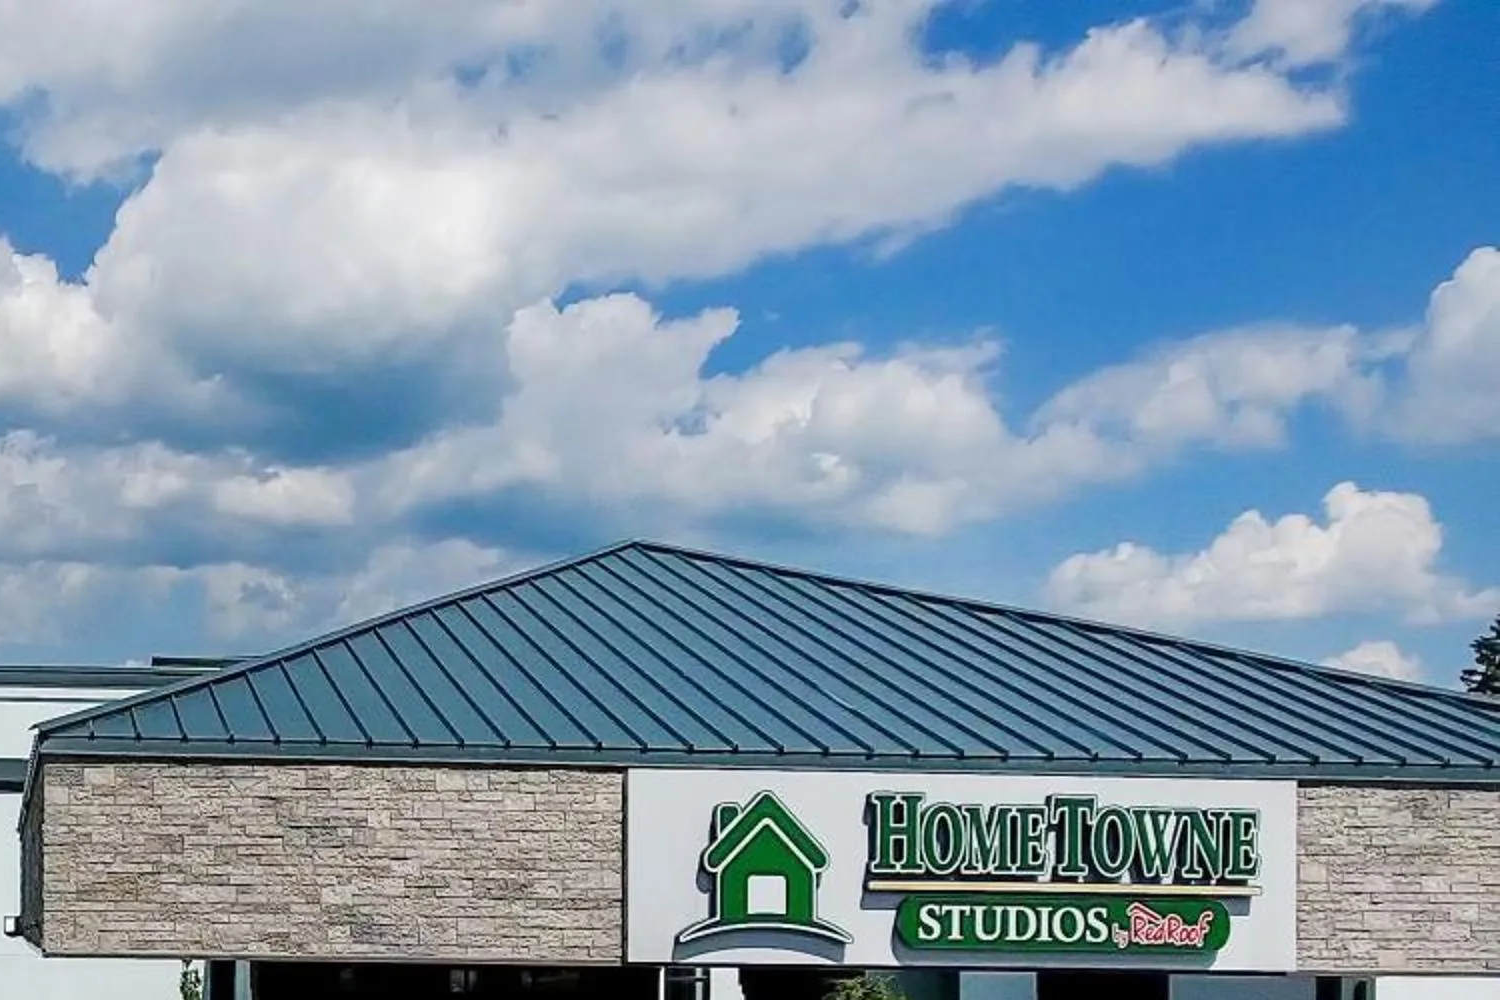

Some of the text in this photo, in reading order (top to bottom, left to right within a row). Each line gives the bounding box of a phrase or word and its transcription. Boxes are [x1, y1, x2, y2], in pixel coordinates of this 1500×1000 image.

[871, 793, 1260, 880] HOMETOWNE
[918, 903, 1109, 943] STUDIOS
[1112, 923, 1129, 948] by
[1164, 911, 1214, 946] Roof
